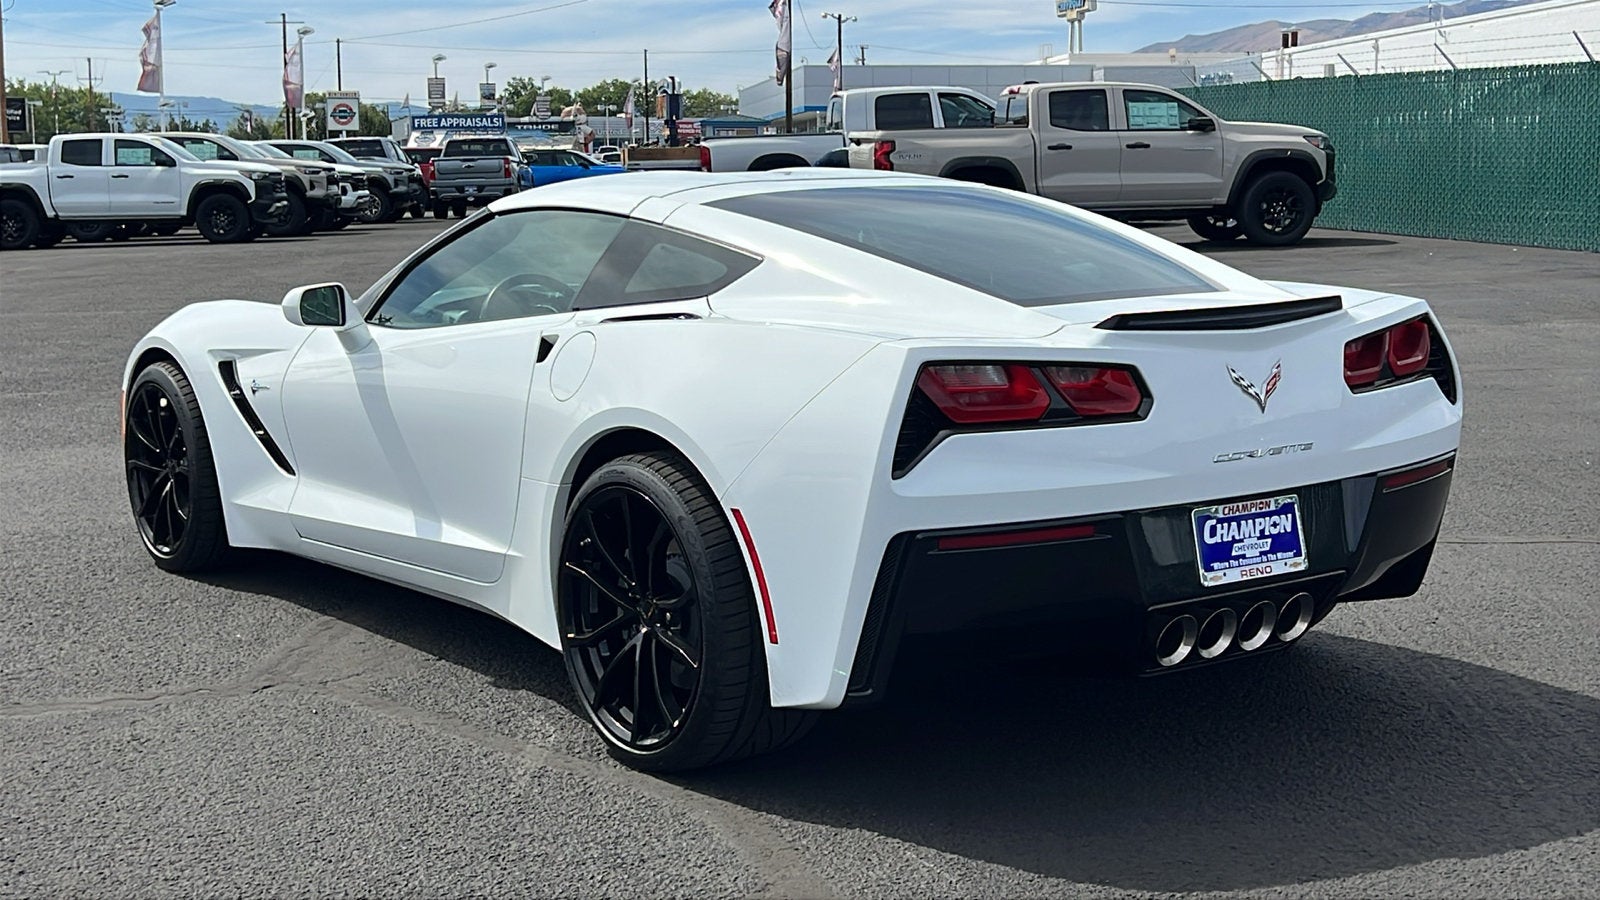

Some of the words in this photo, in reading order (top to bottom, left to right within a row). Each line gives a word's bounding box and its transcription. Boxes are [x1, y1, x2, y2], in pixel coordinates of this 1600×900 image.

[414, 118, 438, 128] FREE
[440, 117, 502, 127] APPRAISALS!
[1212, 442, 1314, 463] CORVETTE
[1222, 500, 1271, 516] CHAMPION
[1203, 513, 1292, 544] CHAMPION
[1234, 541, 1269, 553] CHEVROLET
[1240, 565, 1273, 579] RENO
